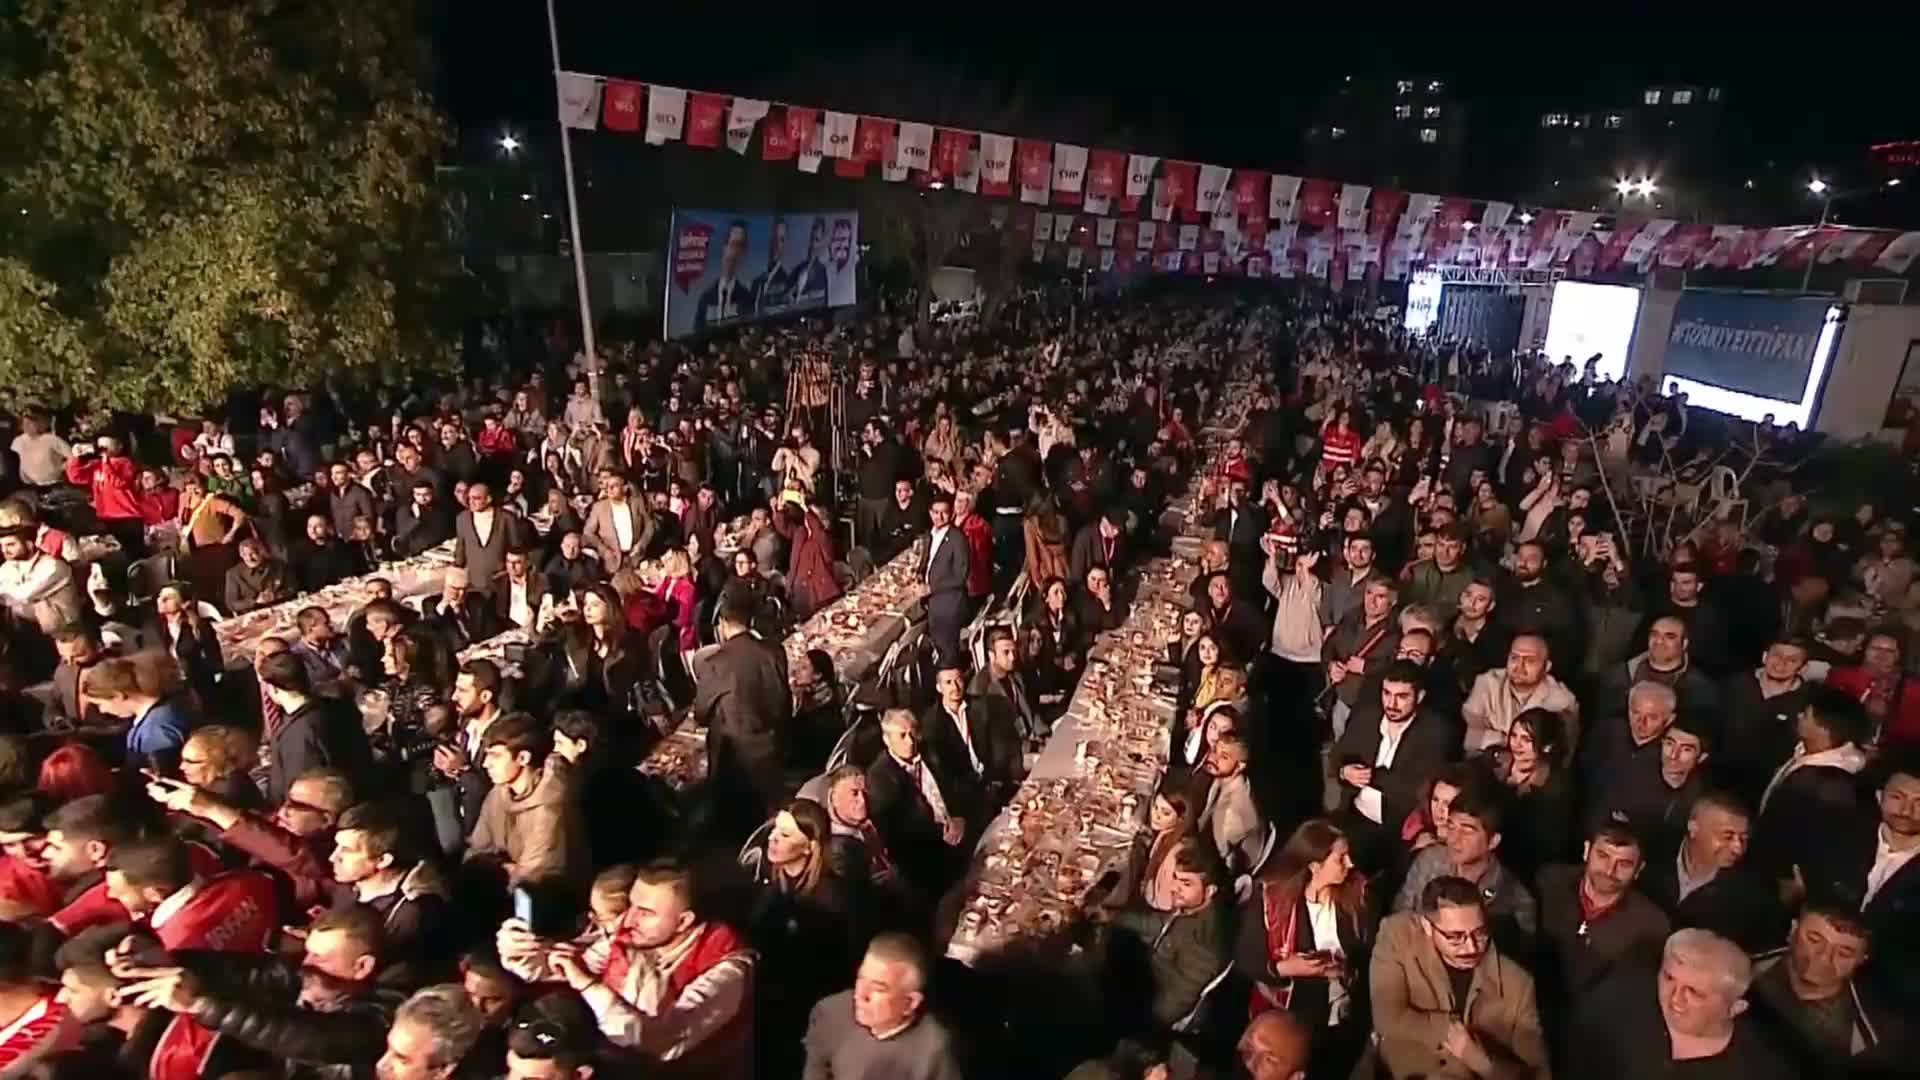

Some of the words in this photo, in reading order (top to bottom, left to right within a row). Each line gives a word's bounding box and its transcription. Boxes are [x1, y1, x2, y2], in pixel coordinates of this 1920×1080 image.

[830, 134, 849, 144] CP
[904, 147, 926, 157] CHP
[1059, 169, 1078, 179] CHP
